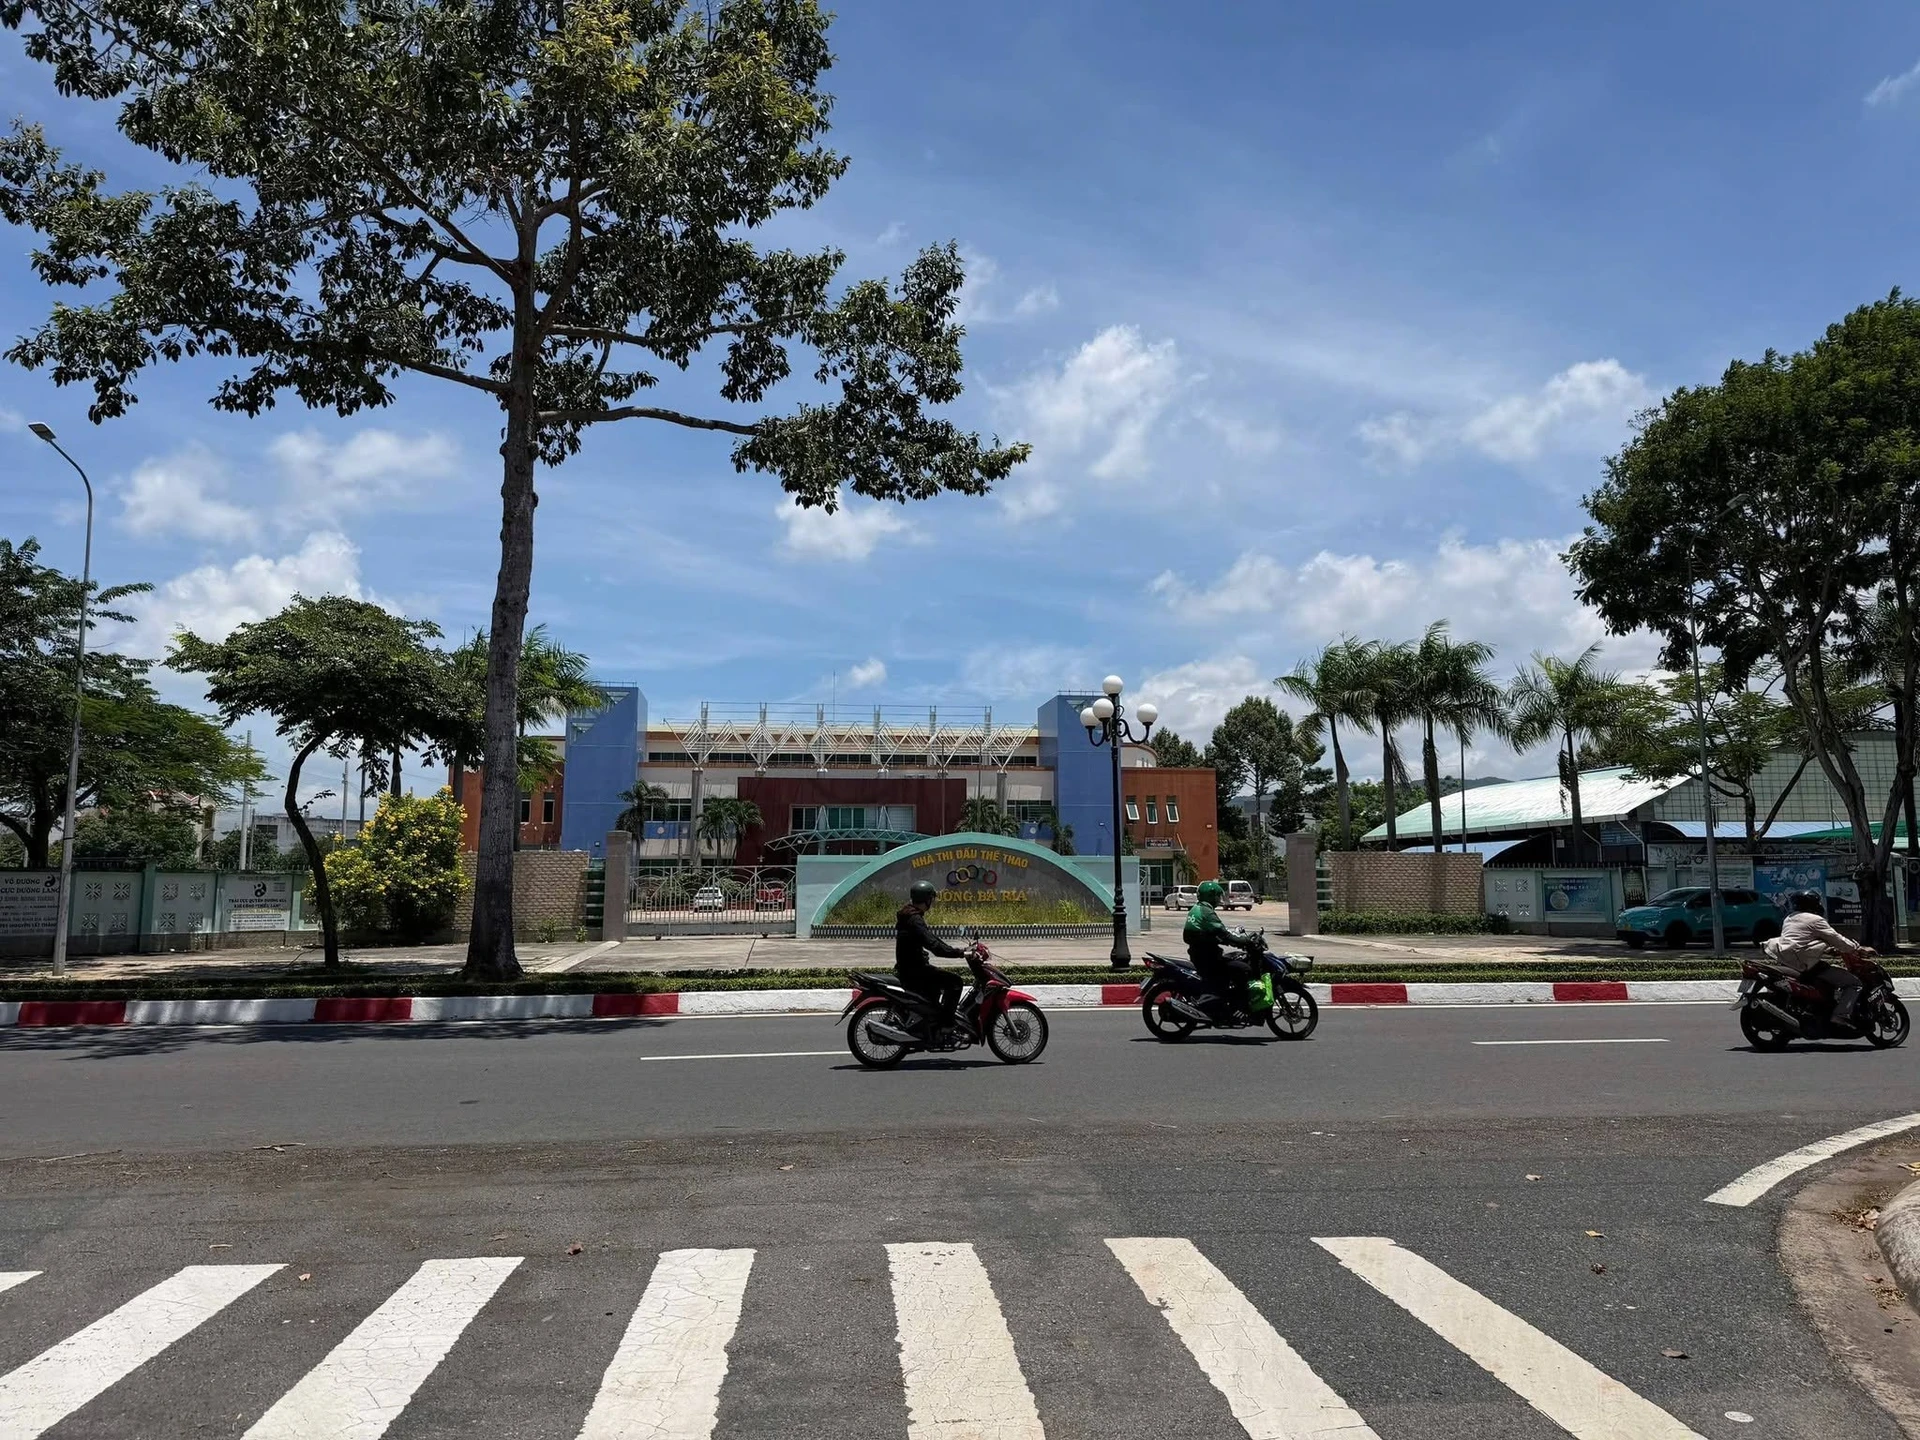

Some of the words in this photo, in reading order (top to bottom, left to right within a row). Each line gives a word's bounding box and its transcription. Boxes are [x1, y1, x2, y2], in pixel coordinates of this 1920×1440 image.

[911, 853, 935, 868] NHÀ
[936, 851, 953, 862] THI
[1003, 853, 1029, 868] THAO
